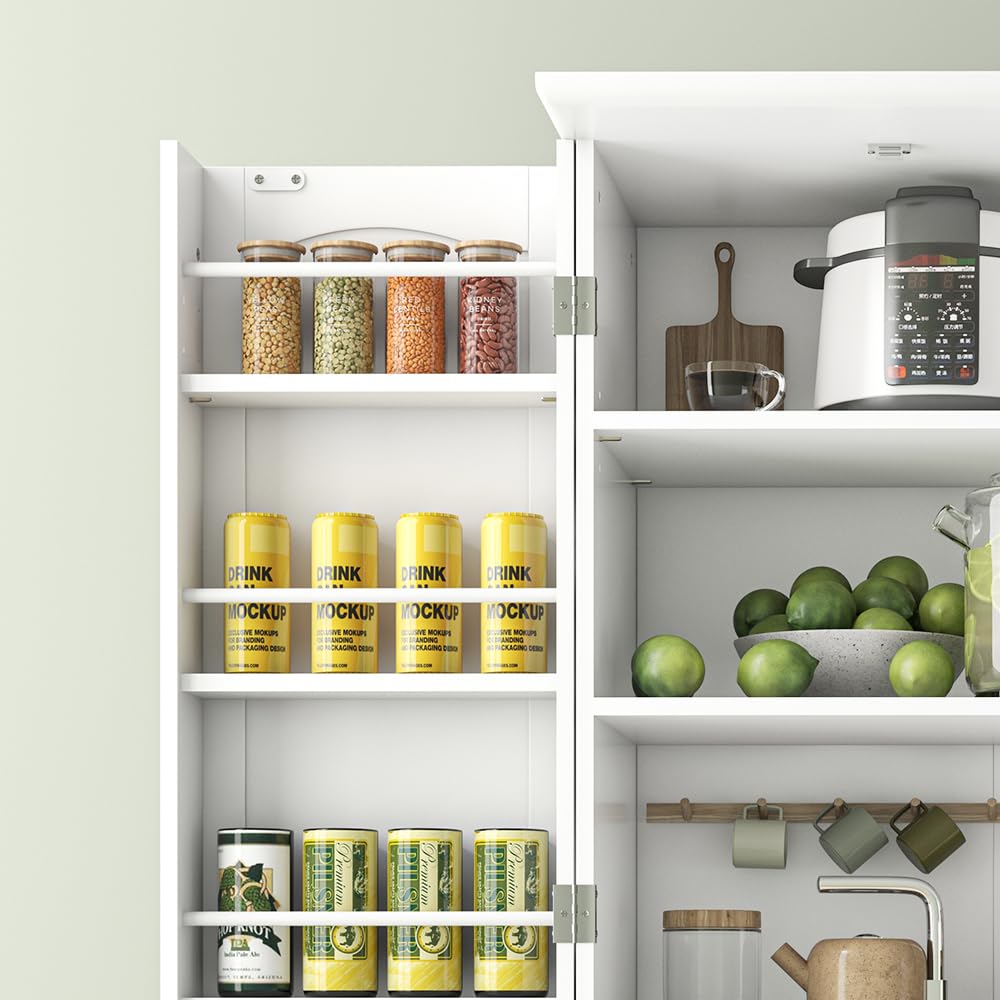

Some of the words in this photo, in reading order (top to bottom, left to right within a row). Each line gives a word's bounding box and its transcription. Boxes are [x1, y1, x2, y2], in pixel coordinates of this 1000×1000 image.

[466, 296, 503, 304] KIDNEY
[469, 305, 501, 313] BEANS
[228, 566, 272, 582] DRINK
[317, 566, 361, 582] DRINK
[402, 566, 446, 582] DRINK
[488, 566, 532, 582] DRINK
[228, 603, 286, 620] MOCKUP
[317, 603, 375, 620] MOCKUP
[402, 603, 459, 620] MOCKUP
[488, 603, 545, 620] MOCKUP
